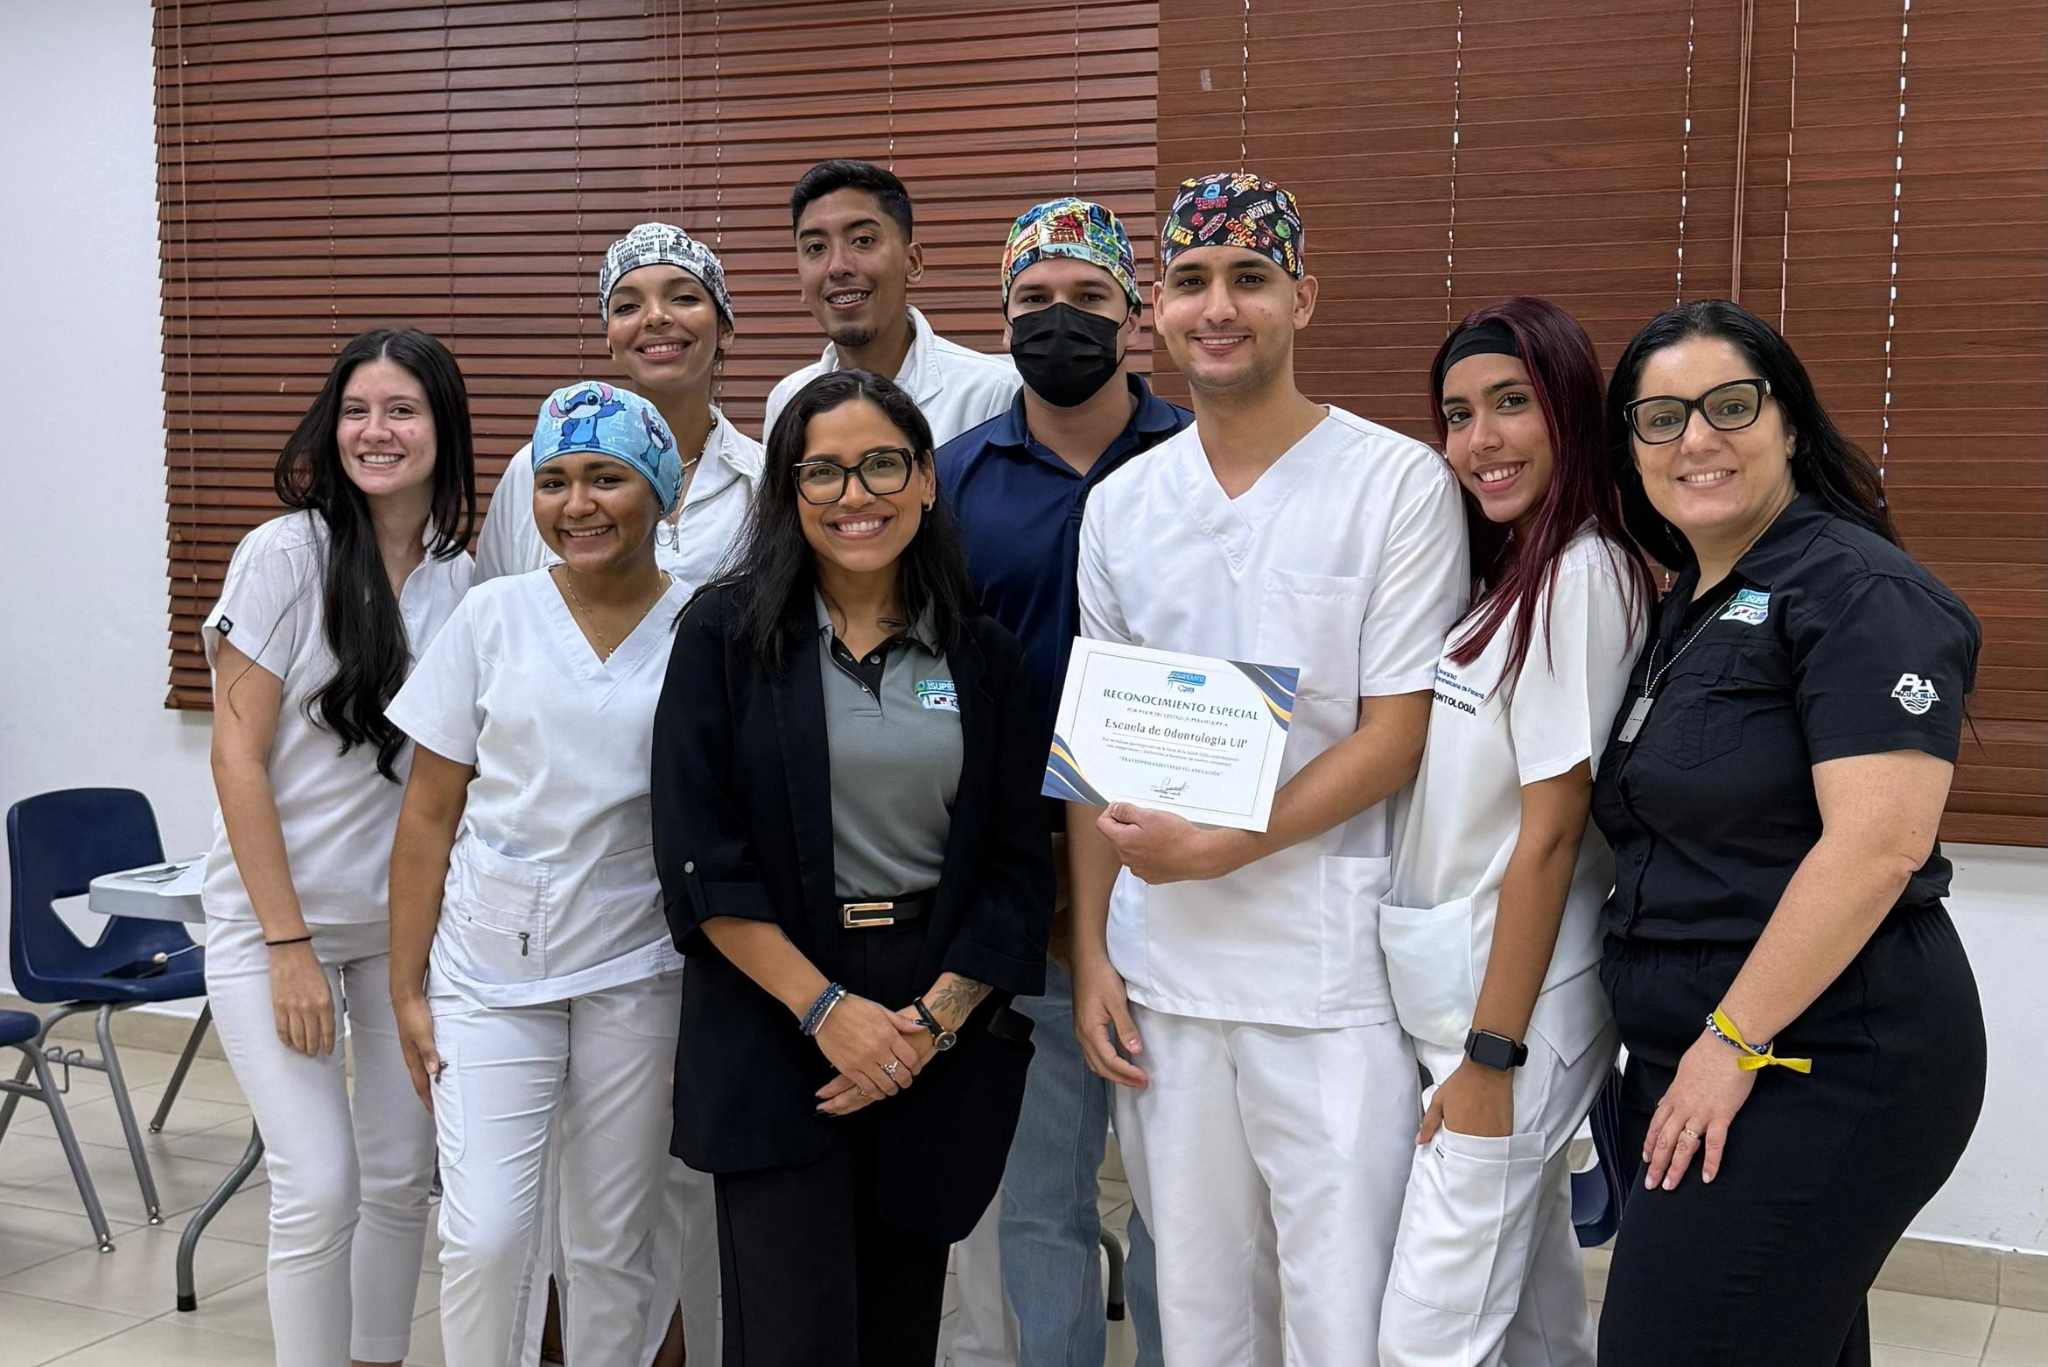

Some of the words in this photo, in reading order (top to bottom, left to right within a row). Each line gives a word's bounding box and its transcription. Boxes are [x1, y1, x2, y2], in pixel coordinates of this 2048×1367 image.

[1103, 688, 1206, 713] RECONOCIMIENTO
[1209, 704, 1258, 721] ESPECIAL
[1105, 717, 1146, 734] Escuela
[1148, 724, 1161, 736] de
